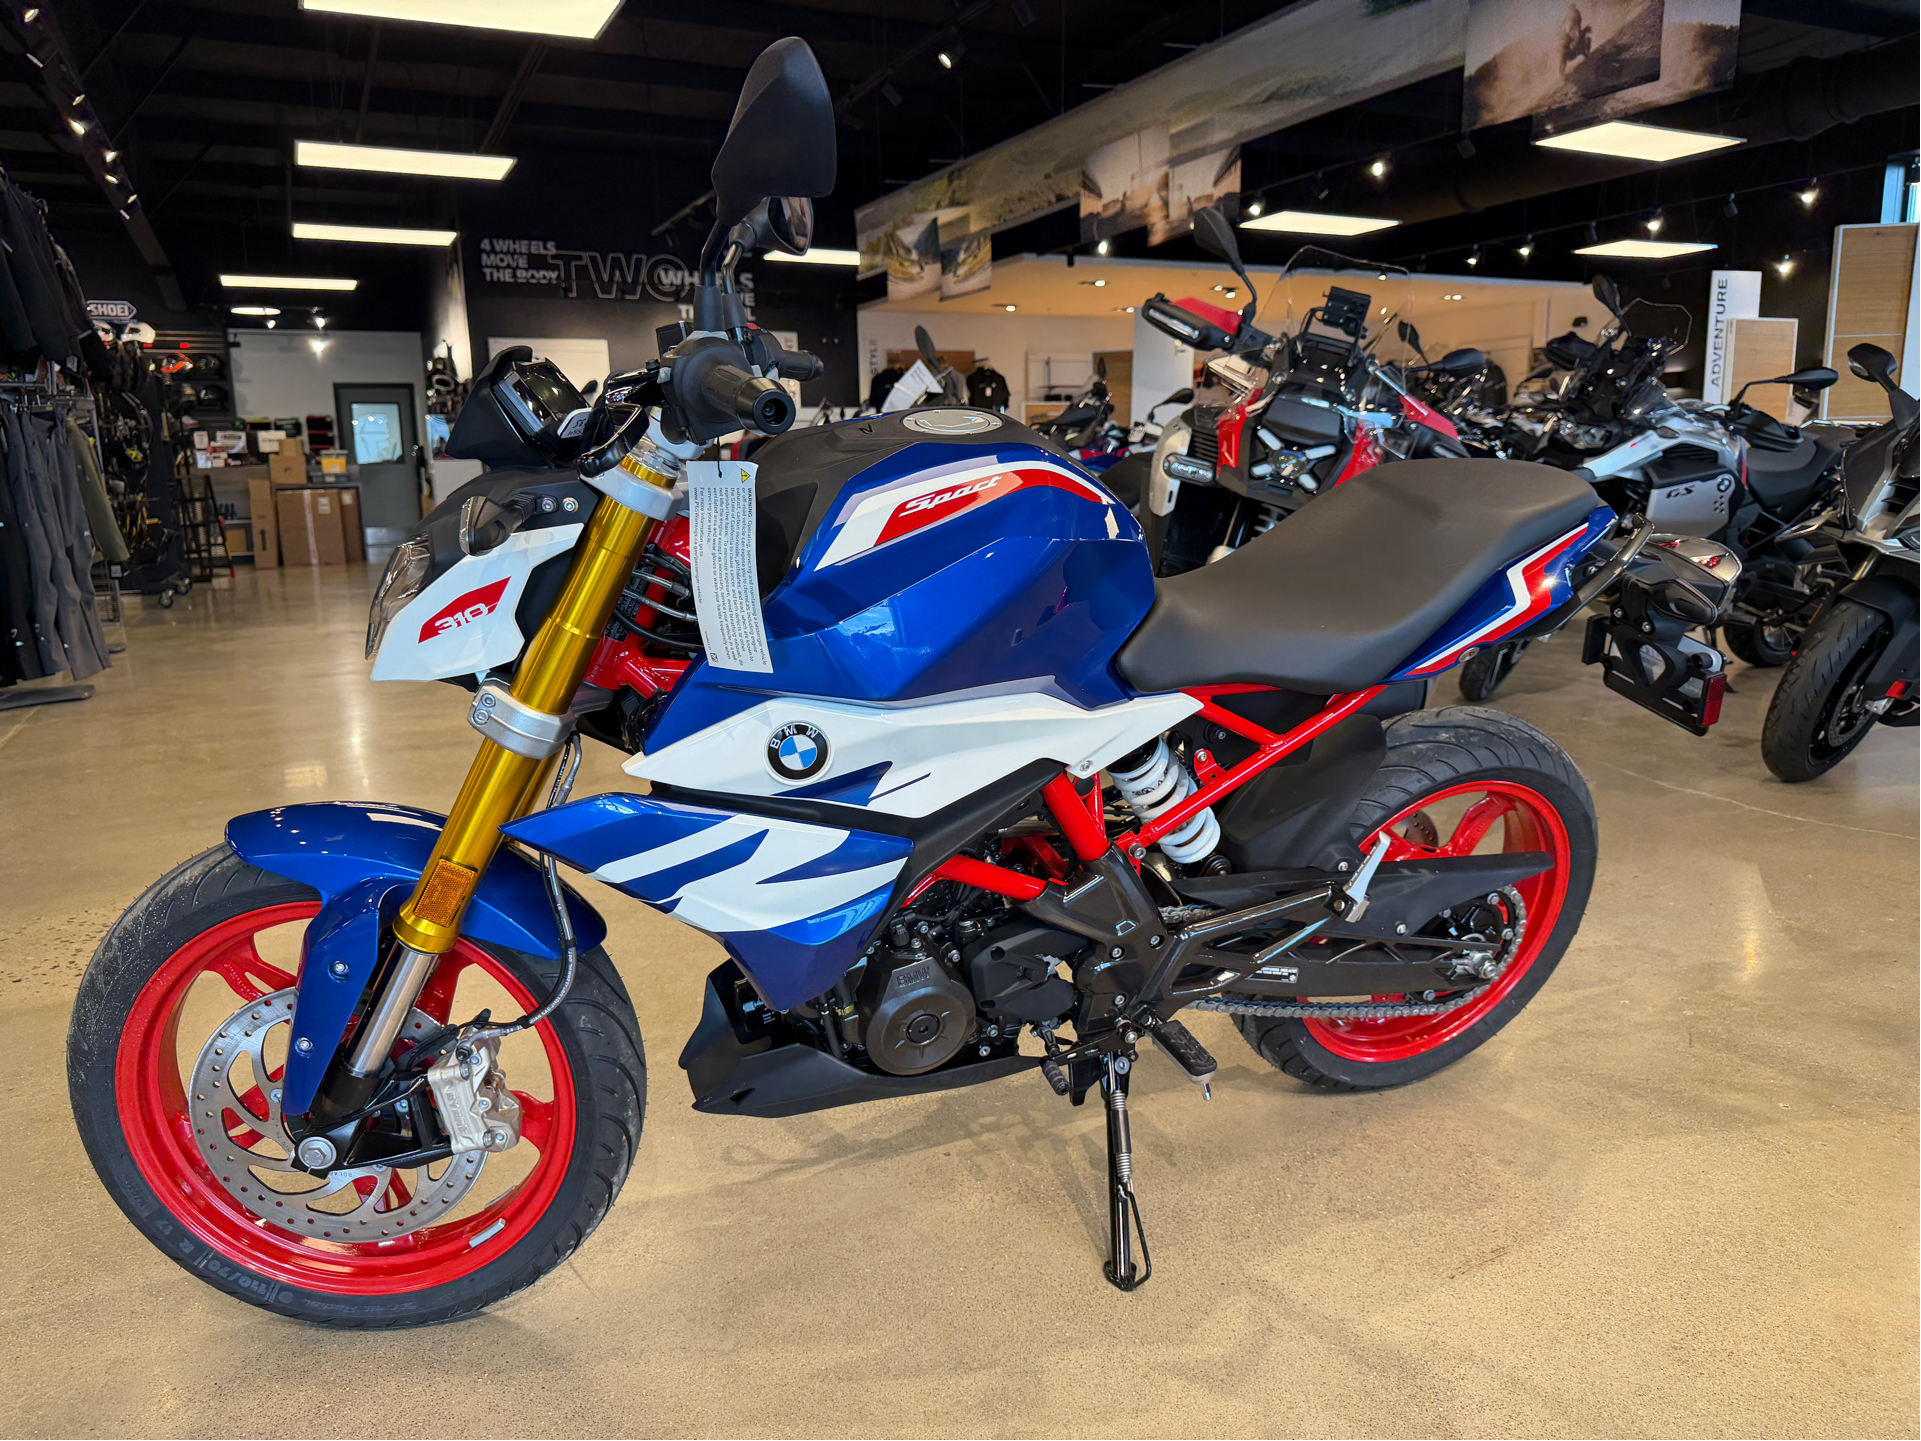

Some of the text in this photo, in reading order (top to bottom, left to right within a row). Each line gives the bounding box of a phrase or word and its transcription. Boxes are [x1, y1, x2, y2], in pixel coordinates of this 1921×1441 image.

[480, 238, 556, 254] 4 WHEELS
[482, 254, 528, 268] MOVE
[483, 268, 560, 284] THE BODY
[548, 250, 689, 302] TWO
[90, 304, 130, 316] SHOEI
[1711, 278, 1728, 388] ADVENTURE
[868, 338, 878, 375] STYLE
[1666, 484, 1696, 498] GS
[435, 603, 489, 634] 310
[896, 966, 930, 988] BMW
[207, 1259, 267, 1294] 110/70
